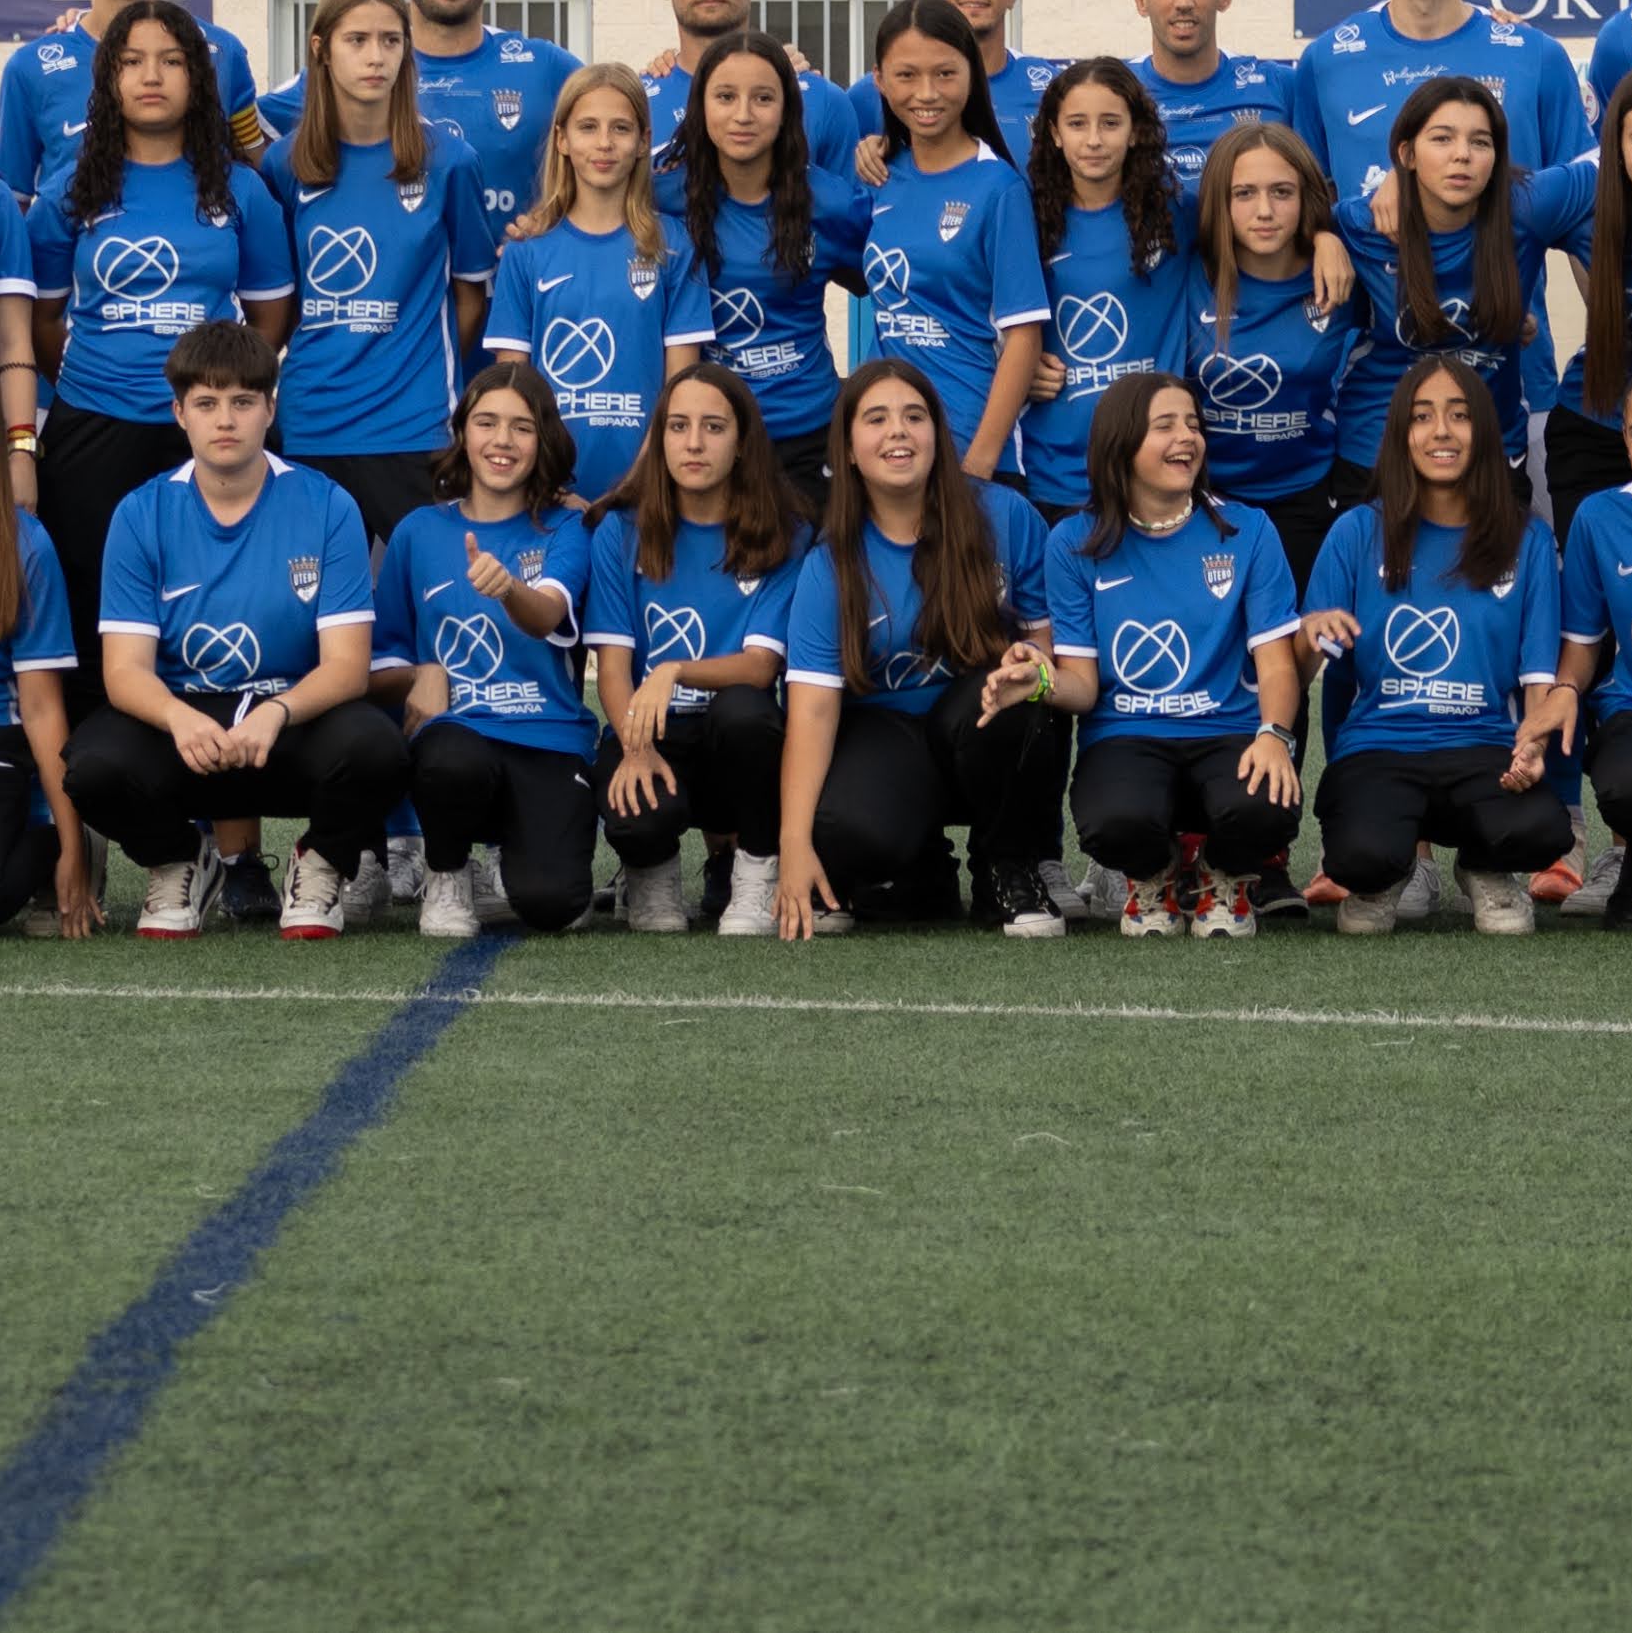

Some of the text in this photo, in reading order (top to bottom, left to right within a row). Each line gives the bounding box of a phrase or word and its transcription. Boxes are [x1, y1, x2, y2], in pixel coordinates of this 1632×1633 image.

[101, 302, 206, 323] SPHERE
[303, 300, 399, 320] SPHERE
[153, 324, 196, 335] ESPA
[557, 392, 640, 412] PHERE
[589, 418, 639, 428] ESPAÑA
[1255, 429, 1305, 443] ESPAÑA
[292, 570, 319, 585] UTEBO
[1205, 566, 1234, 582] UTEBO
[1380, 678, 1484, 702] SPHERE
[1114, 690, 1213, 715] SPHERE
[1427, 704, 1481, 716] ESPAÑA
